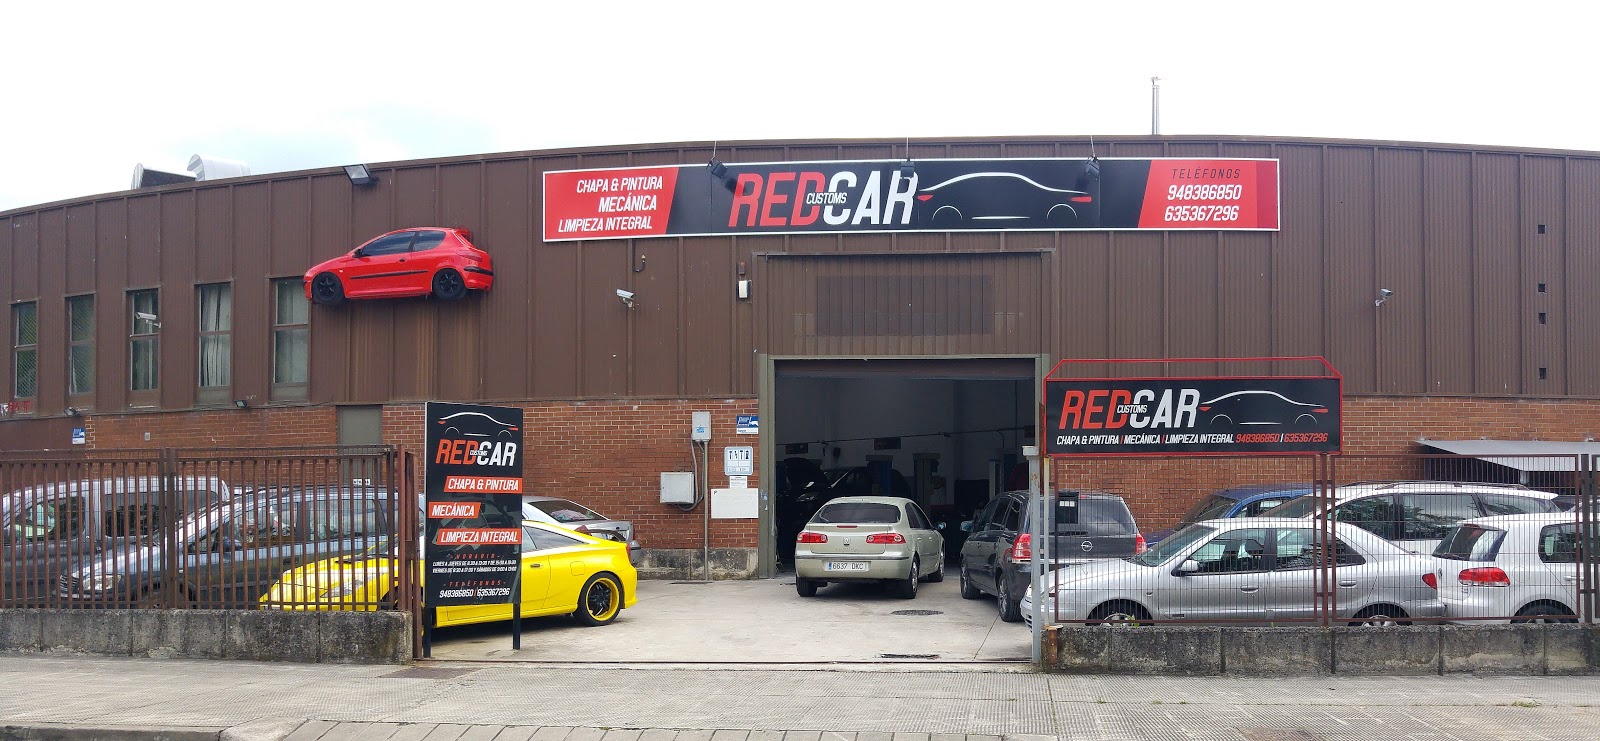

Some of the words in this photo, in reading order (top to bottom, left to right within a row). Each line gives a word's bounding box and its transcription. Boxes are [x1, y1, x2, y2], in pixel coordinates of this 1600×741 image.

[1172, 166, 1241, 179] TELÉFONOS
[576, 178, 609, 194] CHAPA
[611, 178, 619, 192] &
[620, 176, 663, 191] PINTURA
[806, 191, 848, 205] CUSTOMS
[1167, 184, 1242, 201] 948386850
[598, 193, 657, 213] MECÁNICA
[1164, 205, 1240, 222] 635367296
[558, 217, 603, 233] LIMPIEZA
[605, 216, 653, 231] INTEGRAL
[1116, 404, 1148, 414] CUSTOMS
[1057, 435, 1080, 445] CHAPA
[1081, 435, 1088, 445] &
[1088, 435, 1120, 445] PINTURA
[1123, 433, 1161, 444] MECÁNICA
[1165, 434, 1199, 444] LIMPIEZA
[1199, 433, 1235, 444] INTEGRAL
[1235, 433, 1280, 444] 948386850
[1283, 433, 1329, 443] 635367296
[448, 478, 475, 490] CHAPA
[476, 478, 484, 490] &
[485, 479, 519, 491] PINTURA
[432, 502, 475, 517] MECÁNICA
[440, 531, 479, 543] LIMPIEZA
[480, 531, 519, 543] INTEGRAL
